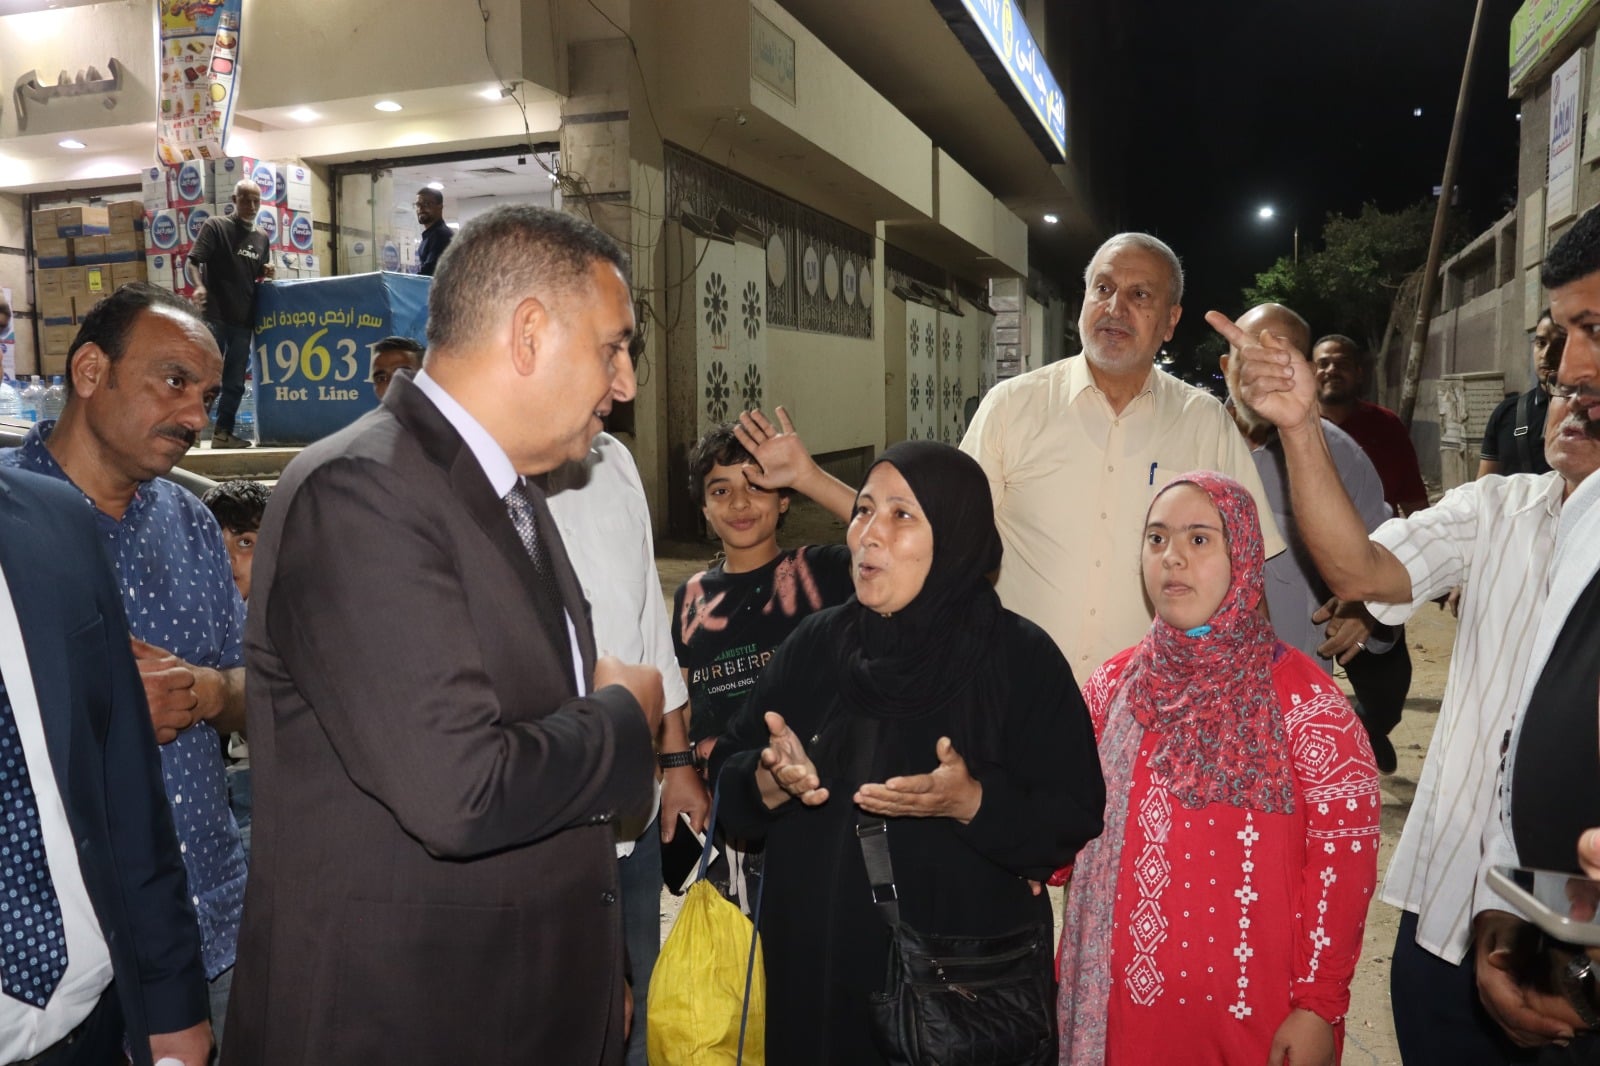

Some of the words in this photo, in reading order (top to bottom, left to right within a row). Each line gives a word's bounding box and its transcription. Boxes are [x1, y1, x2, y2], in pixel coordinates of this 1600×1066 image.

[279, 310, 316, 328] وجودة
[356, 313, 383, 328] سعر
[257, 328, 376, 385] 19631
[275, 386, 308, 401] Hot
[318, 386, 359, 401] Line
[692, 649, 776, 684] BURBERR
